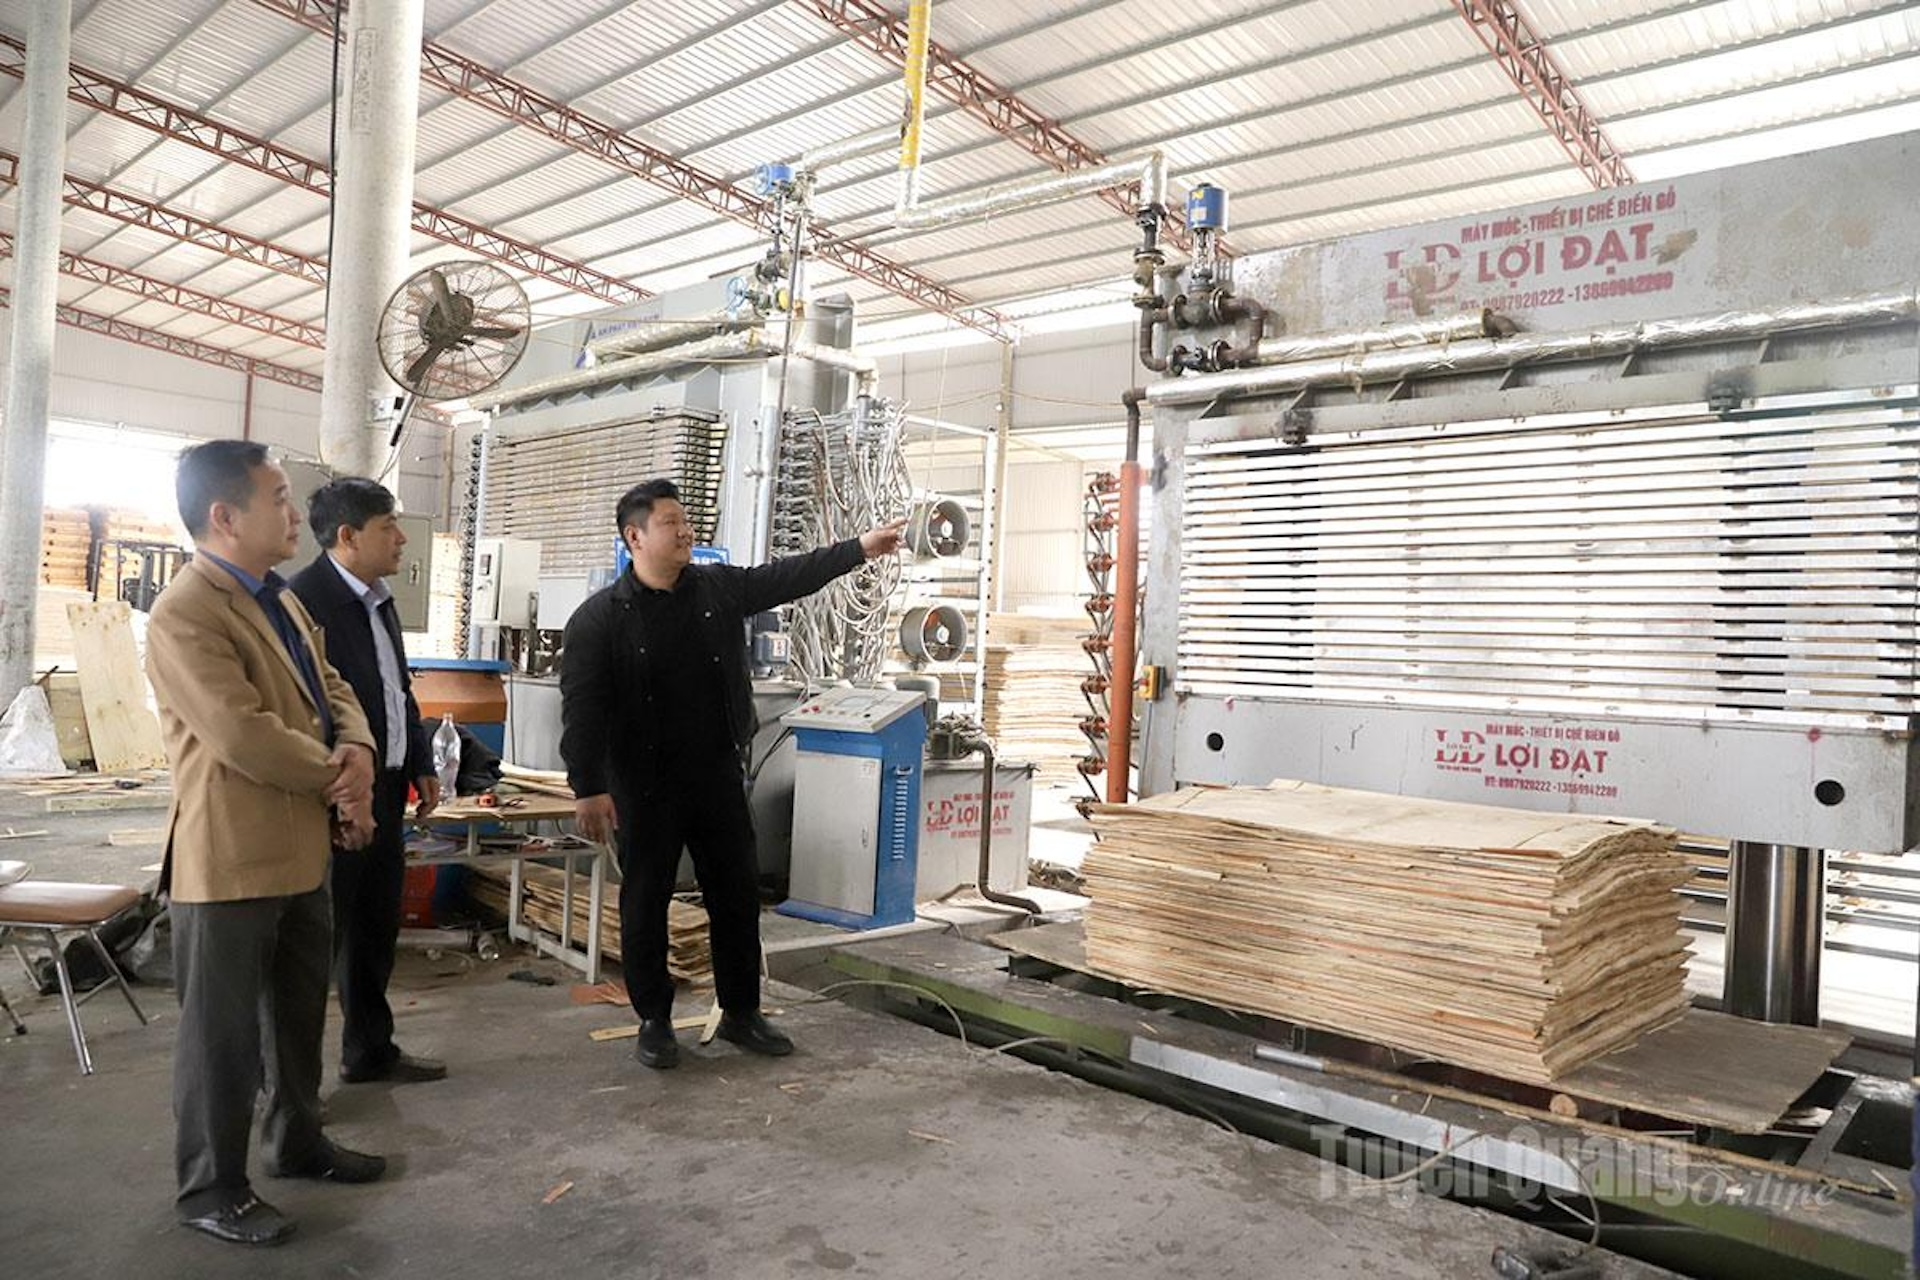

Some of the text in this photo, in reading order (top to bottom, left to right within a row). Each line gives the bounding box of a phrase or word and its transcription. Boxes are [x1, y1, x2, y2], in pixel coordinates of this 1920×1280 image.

[1461, 220, 1489, 244] MÁY
[1477, 223, 1654, 289] LỢI ĐẠT
[1495, 743, 1608, 779] LỢI ĐẠT
